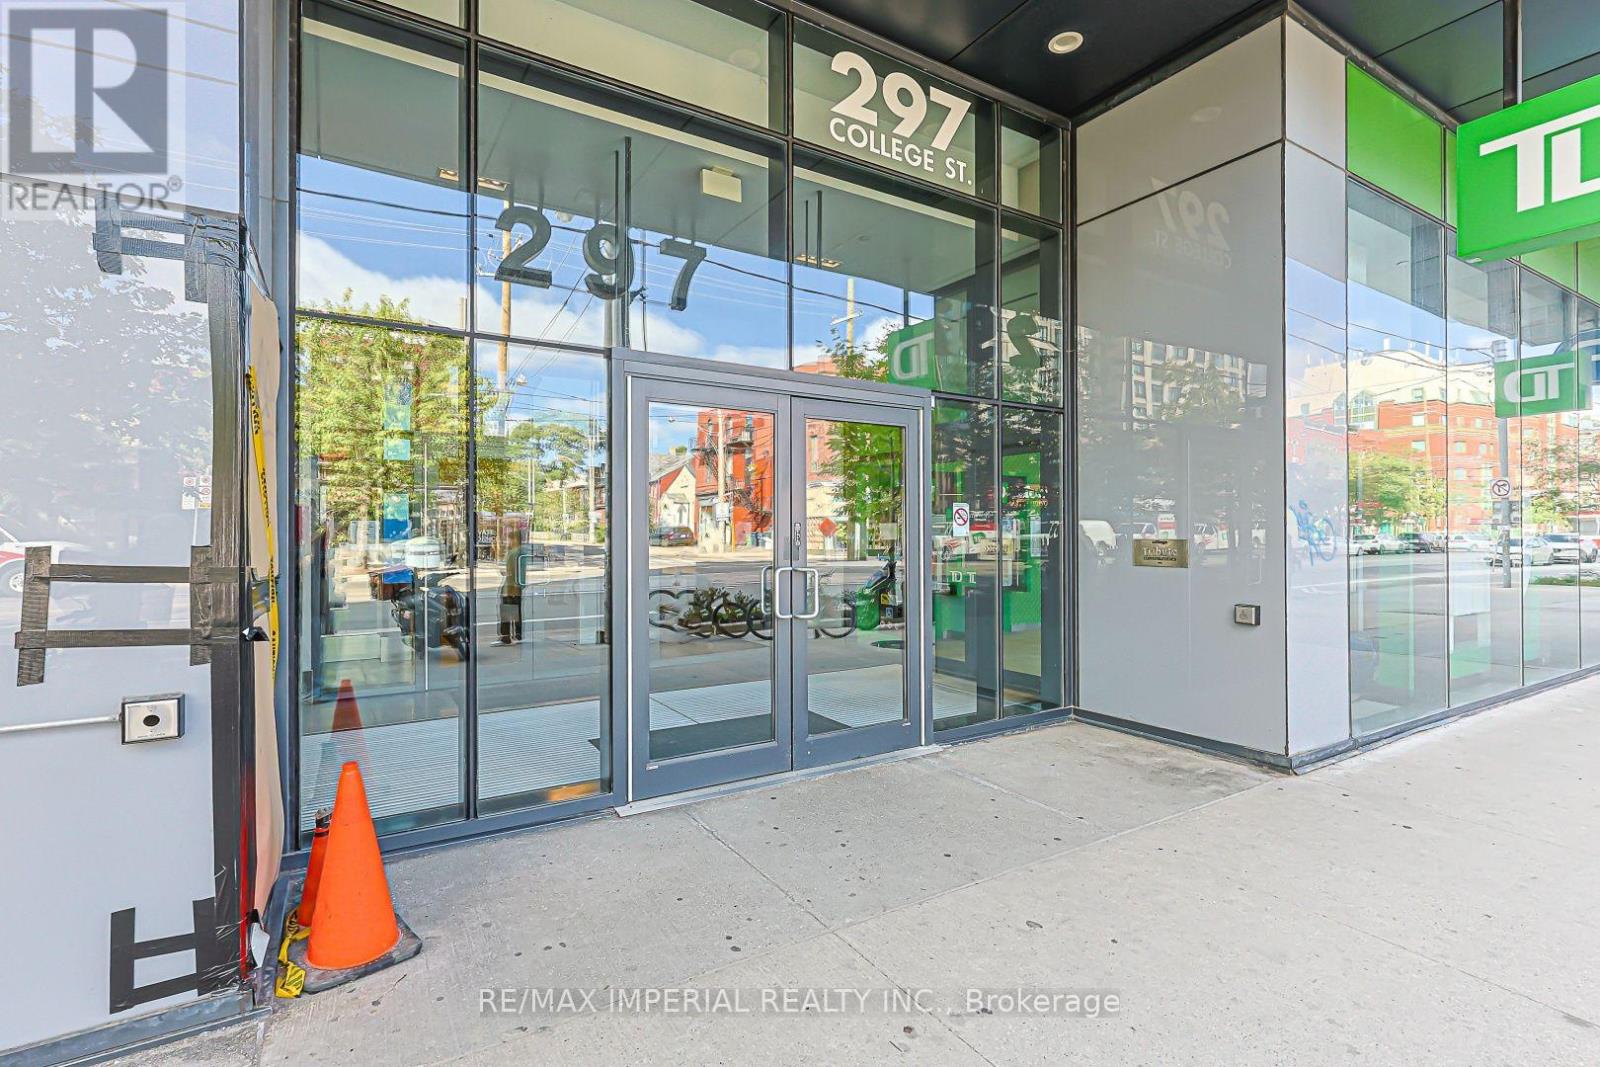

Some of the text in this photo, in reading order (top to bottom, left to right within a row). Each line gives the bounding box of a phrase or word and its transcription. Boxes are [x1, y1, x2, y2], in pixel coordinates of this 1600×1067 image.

[829, 117, 973, 185] COLLEGE ST.
[830, 50, 972, 151] 297
[495, 205, 707, 311] 297
